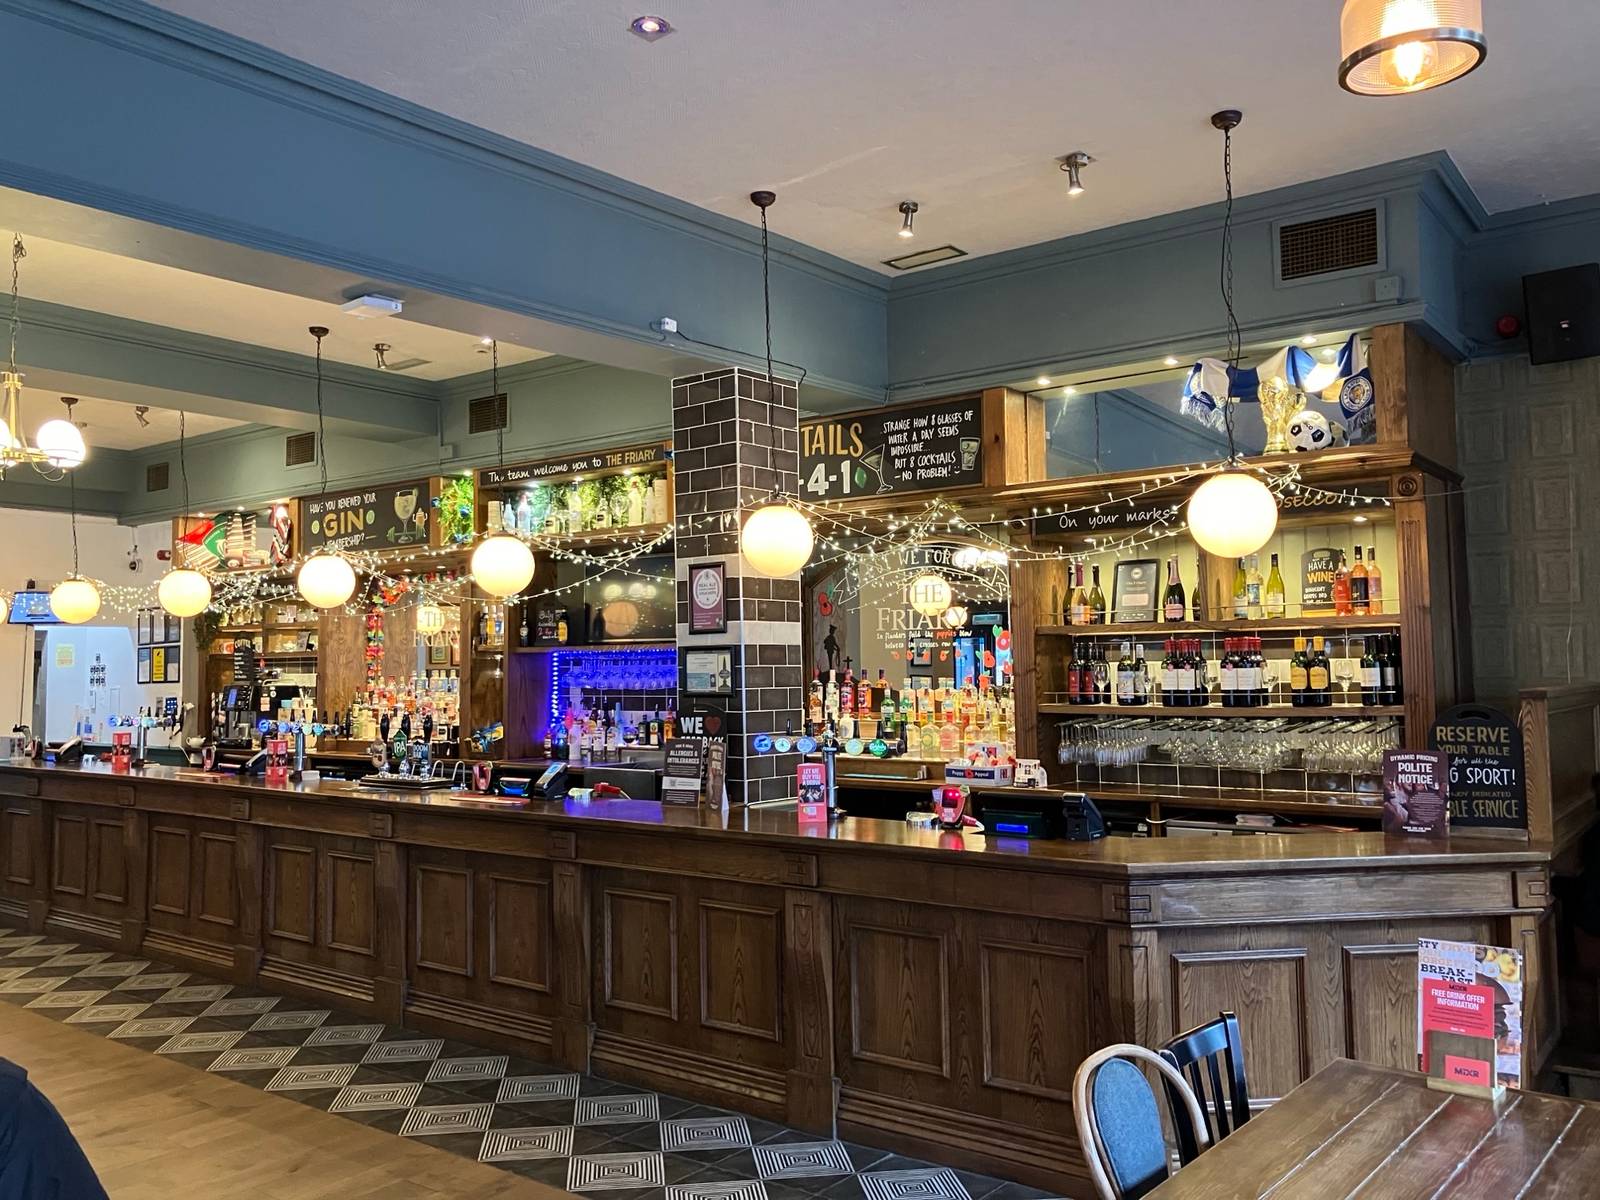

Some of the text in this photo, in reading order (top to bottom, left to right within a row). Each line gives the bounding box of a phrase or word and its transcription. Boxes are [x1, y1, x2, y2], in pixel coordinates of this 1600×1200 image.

[882, 410, 974, 434] STRANGE HOW 8 GLASSES OF
[800, 423, 864, 458] TAILS
[888, 425, 959, 445] WATER A DAY SEEMS
[507, 470, 530, 480] team
[533, 464, 568, 476] welcome
[572, 461, 588, 472] you
[592, 457, 602, 468] to
[606, 454, 622, 467] THE
[625, 449, 656, 463] FRIARY
[894, 451, 956, 469] BUT 8 COCKTAILS
[916, 466, 951, 480] PROBLEM!
[325, 500, 336, 511] YOU
[337, 496, 361, 509] RENEWED
[363, 493, 377, 504] YOUR
[324, 508, 364, 537] GIN
[1059, 515, 1078, 529] On
[1088, 513, 1119, 530] your
[897, 550, 919, 566] WE
[1308, 561, 1334, 572] HAVE A
[1307, 571, 1334, 584] WINE
[896, 583, 944, 604] THE
[876, 607, 969, 631] FRIARY
[680, 716, 704, 734] WE
[1436, 726, 1511, 743] RESERVE
[394, 740, 406, 754] IPA
[1437, 744, 1511, 756] YOUR TABLE
[1389, 754, 1415, 762] DYNAMIC
[1453, 756, 1468, 766] for
[1397, 762, 1433, 773] POLITE
[1398, 773, 1433, 784] NOTICE
[1466, 767, 1516, 786] SPORT!
[1472, 800, 1520, 818] SERVICE
[1431, 988, 1485, 1005] FREE DRINK OFFER
[1436, 997, 1479, 1011] INFORMATION
